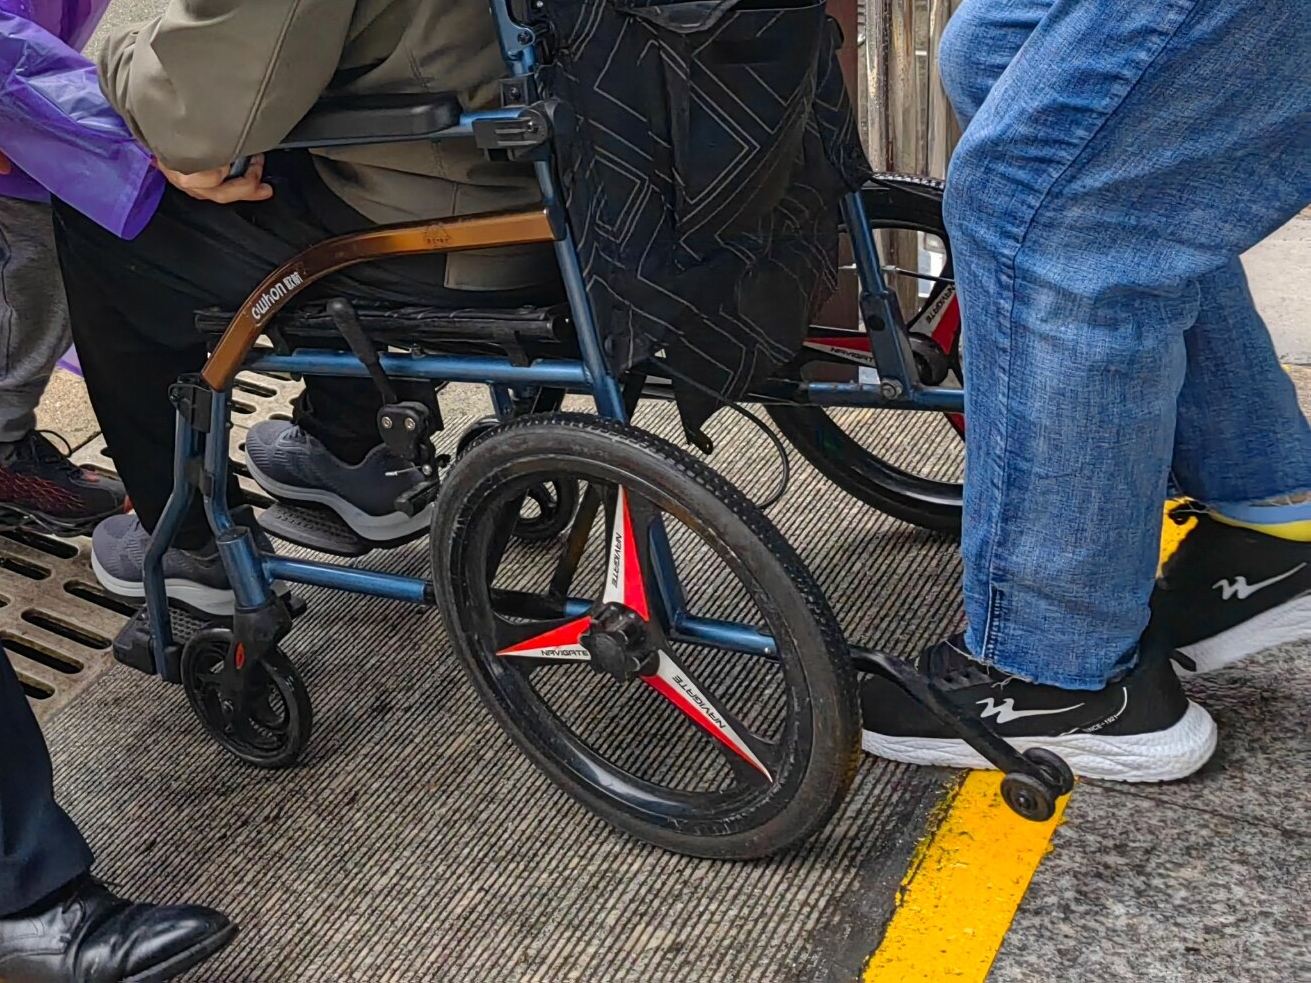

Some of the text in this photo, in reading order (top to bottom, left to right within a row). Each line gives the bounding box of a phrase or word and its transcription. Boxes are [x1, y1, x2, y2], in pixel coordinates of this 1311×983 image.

[830, 347, 875, 362] NAVIGAT
[612, 533, 622, 589] NAVIGATE
[541, 649, 589, 657] NAVIGATE
[671, 674, 727, 729] NAVIGATE
